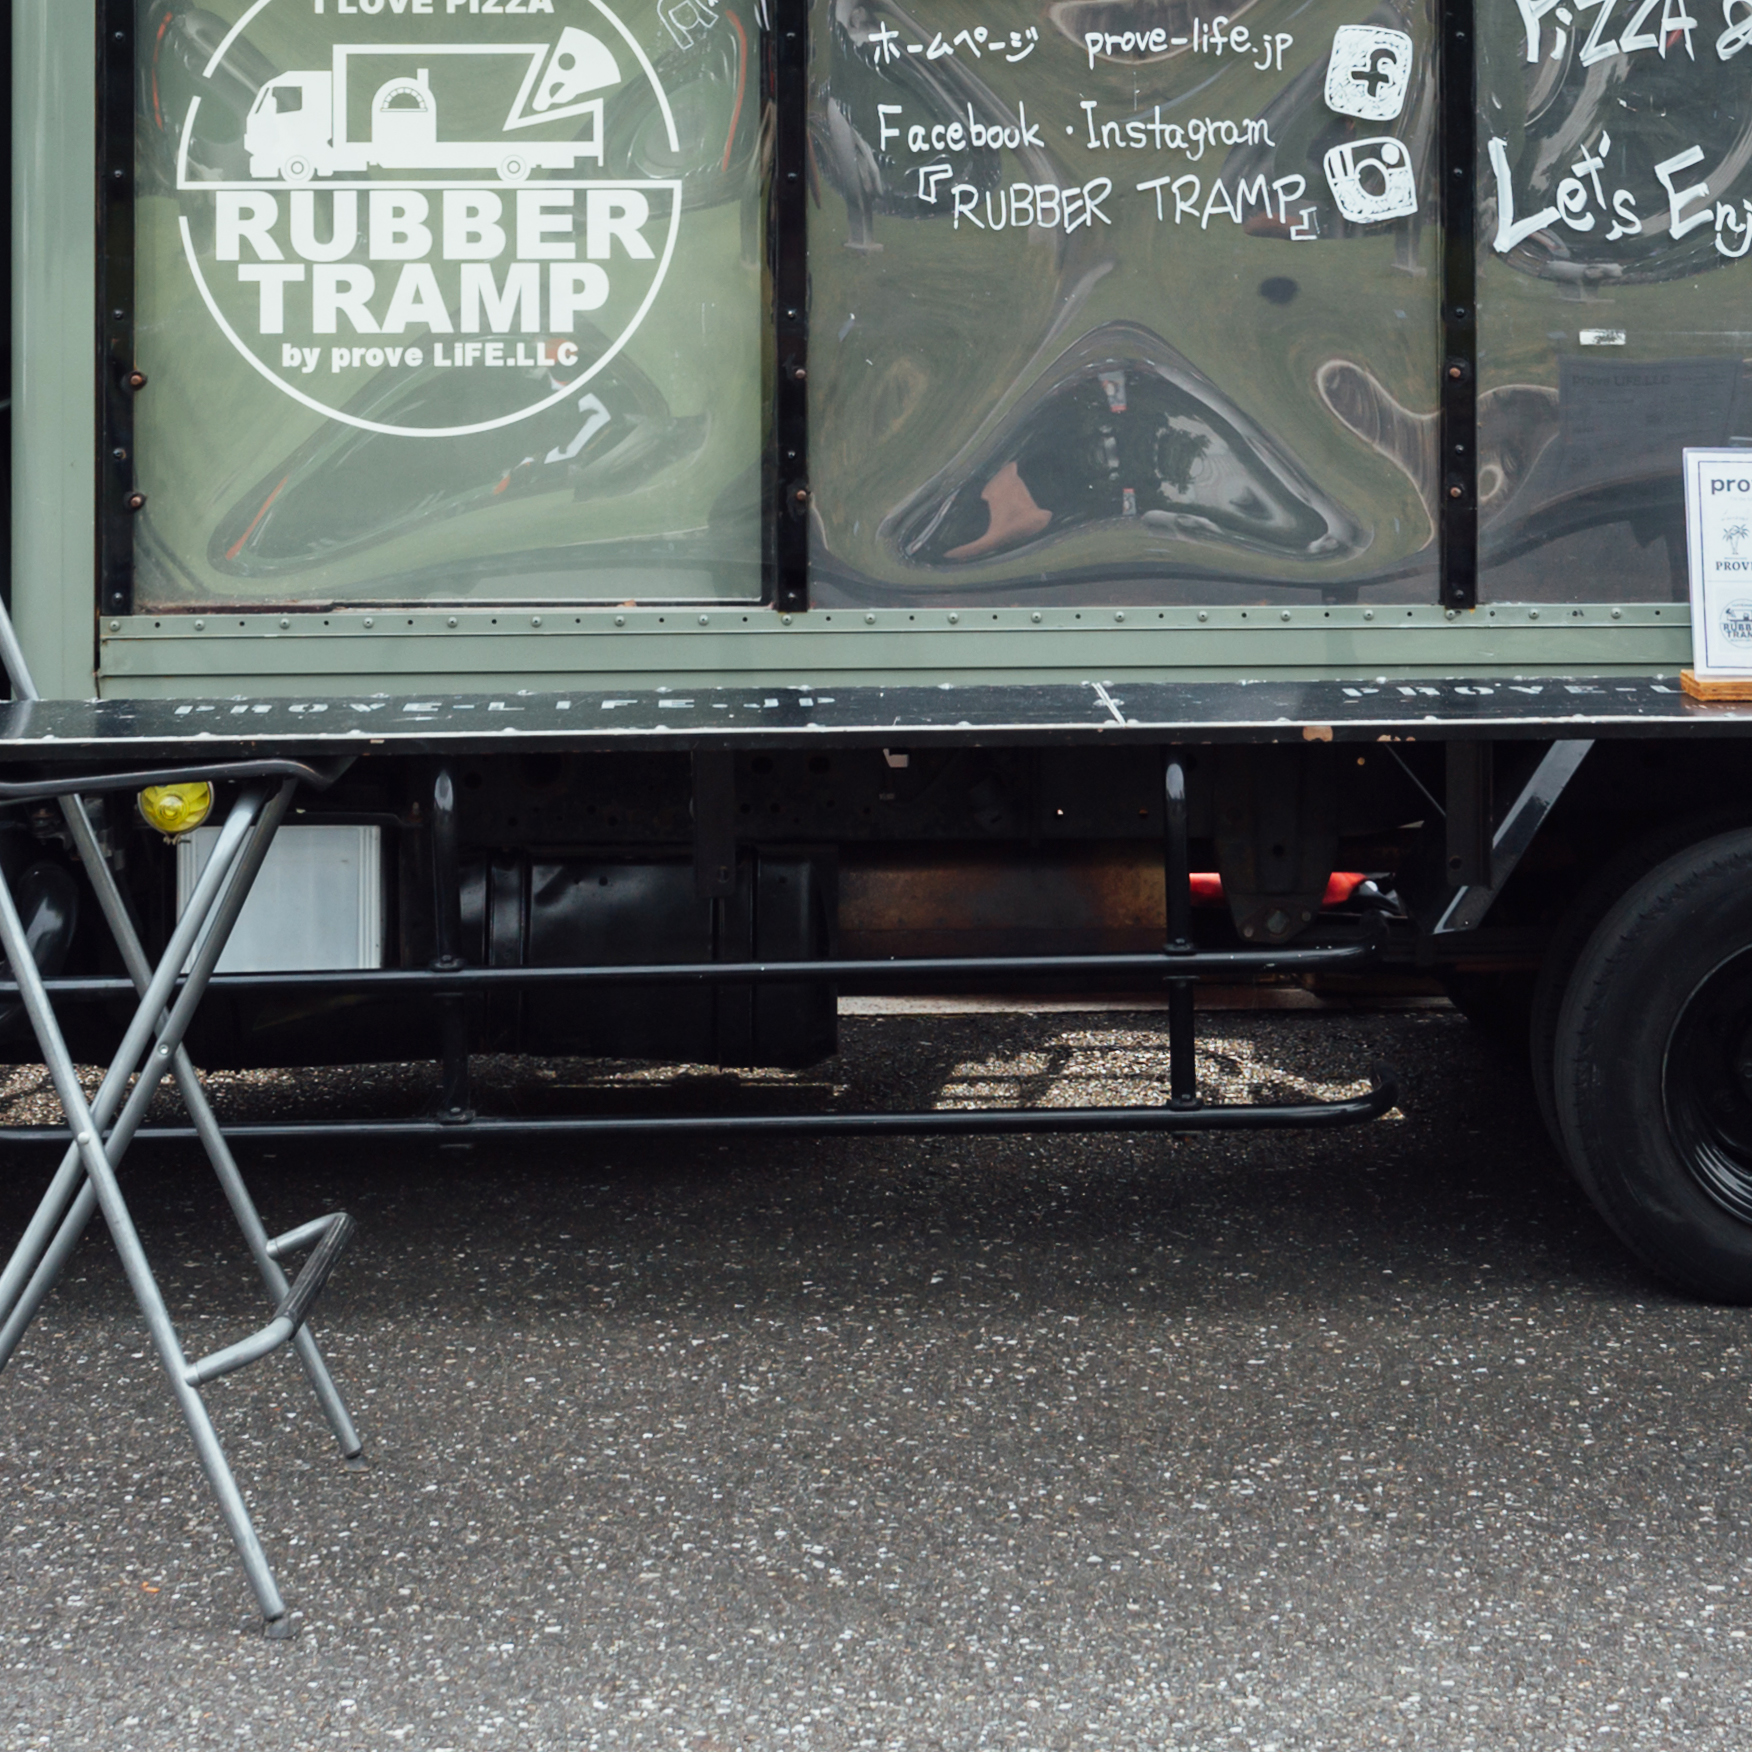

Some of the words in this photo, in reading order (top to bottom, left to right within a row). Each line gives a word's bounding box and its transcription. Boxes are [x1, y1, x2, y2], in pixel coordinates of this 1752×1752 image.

[868, 21, 1039, 65] ホームページ
[877, 102, 1045, 151] Facebook
[215, 189, 656, 262] RUBBER
[237, 263, 611, 335] TRAMP
[281, 342, 318, 373] by
[331, 345, 423, 373] prove
